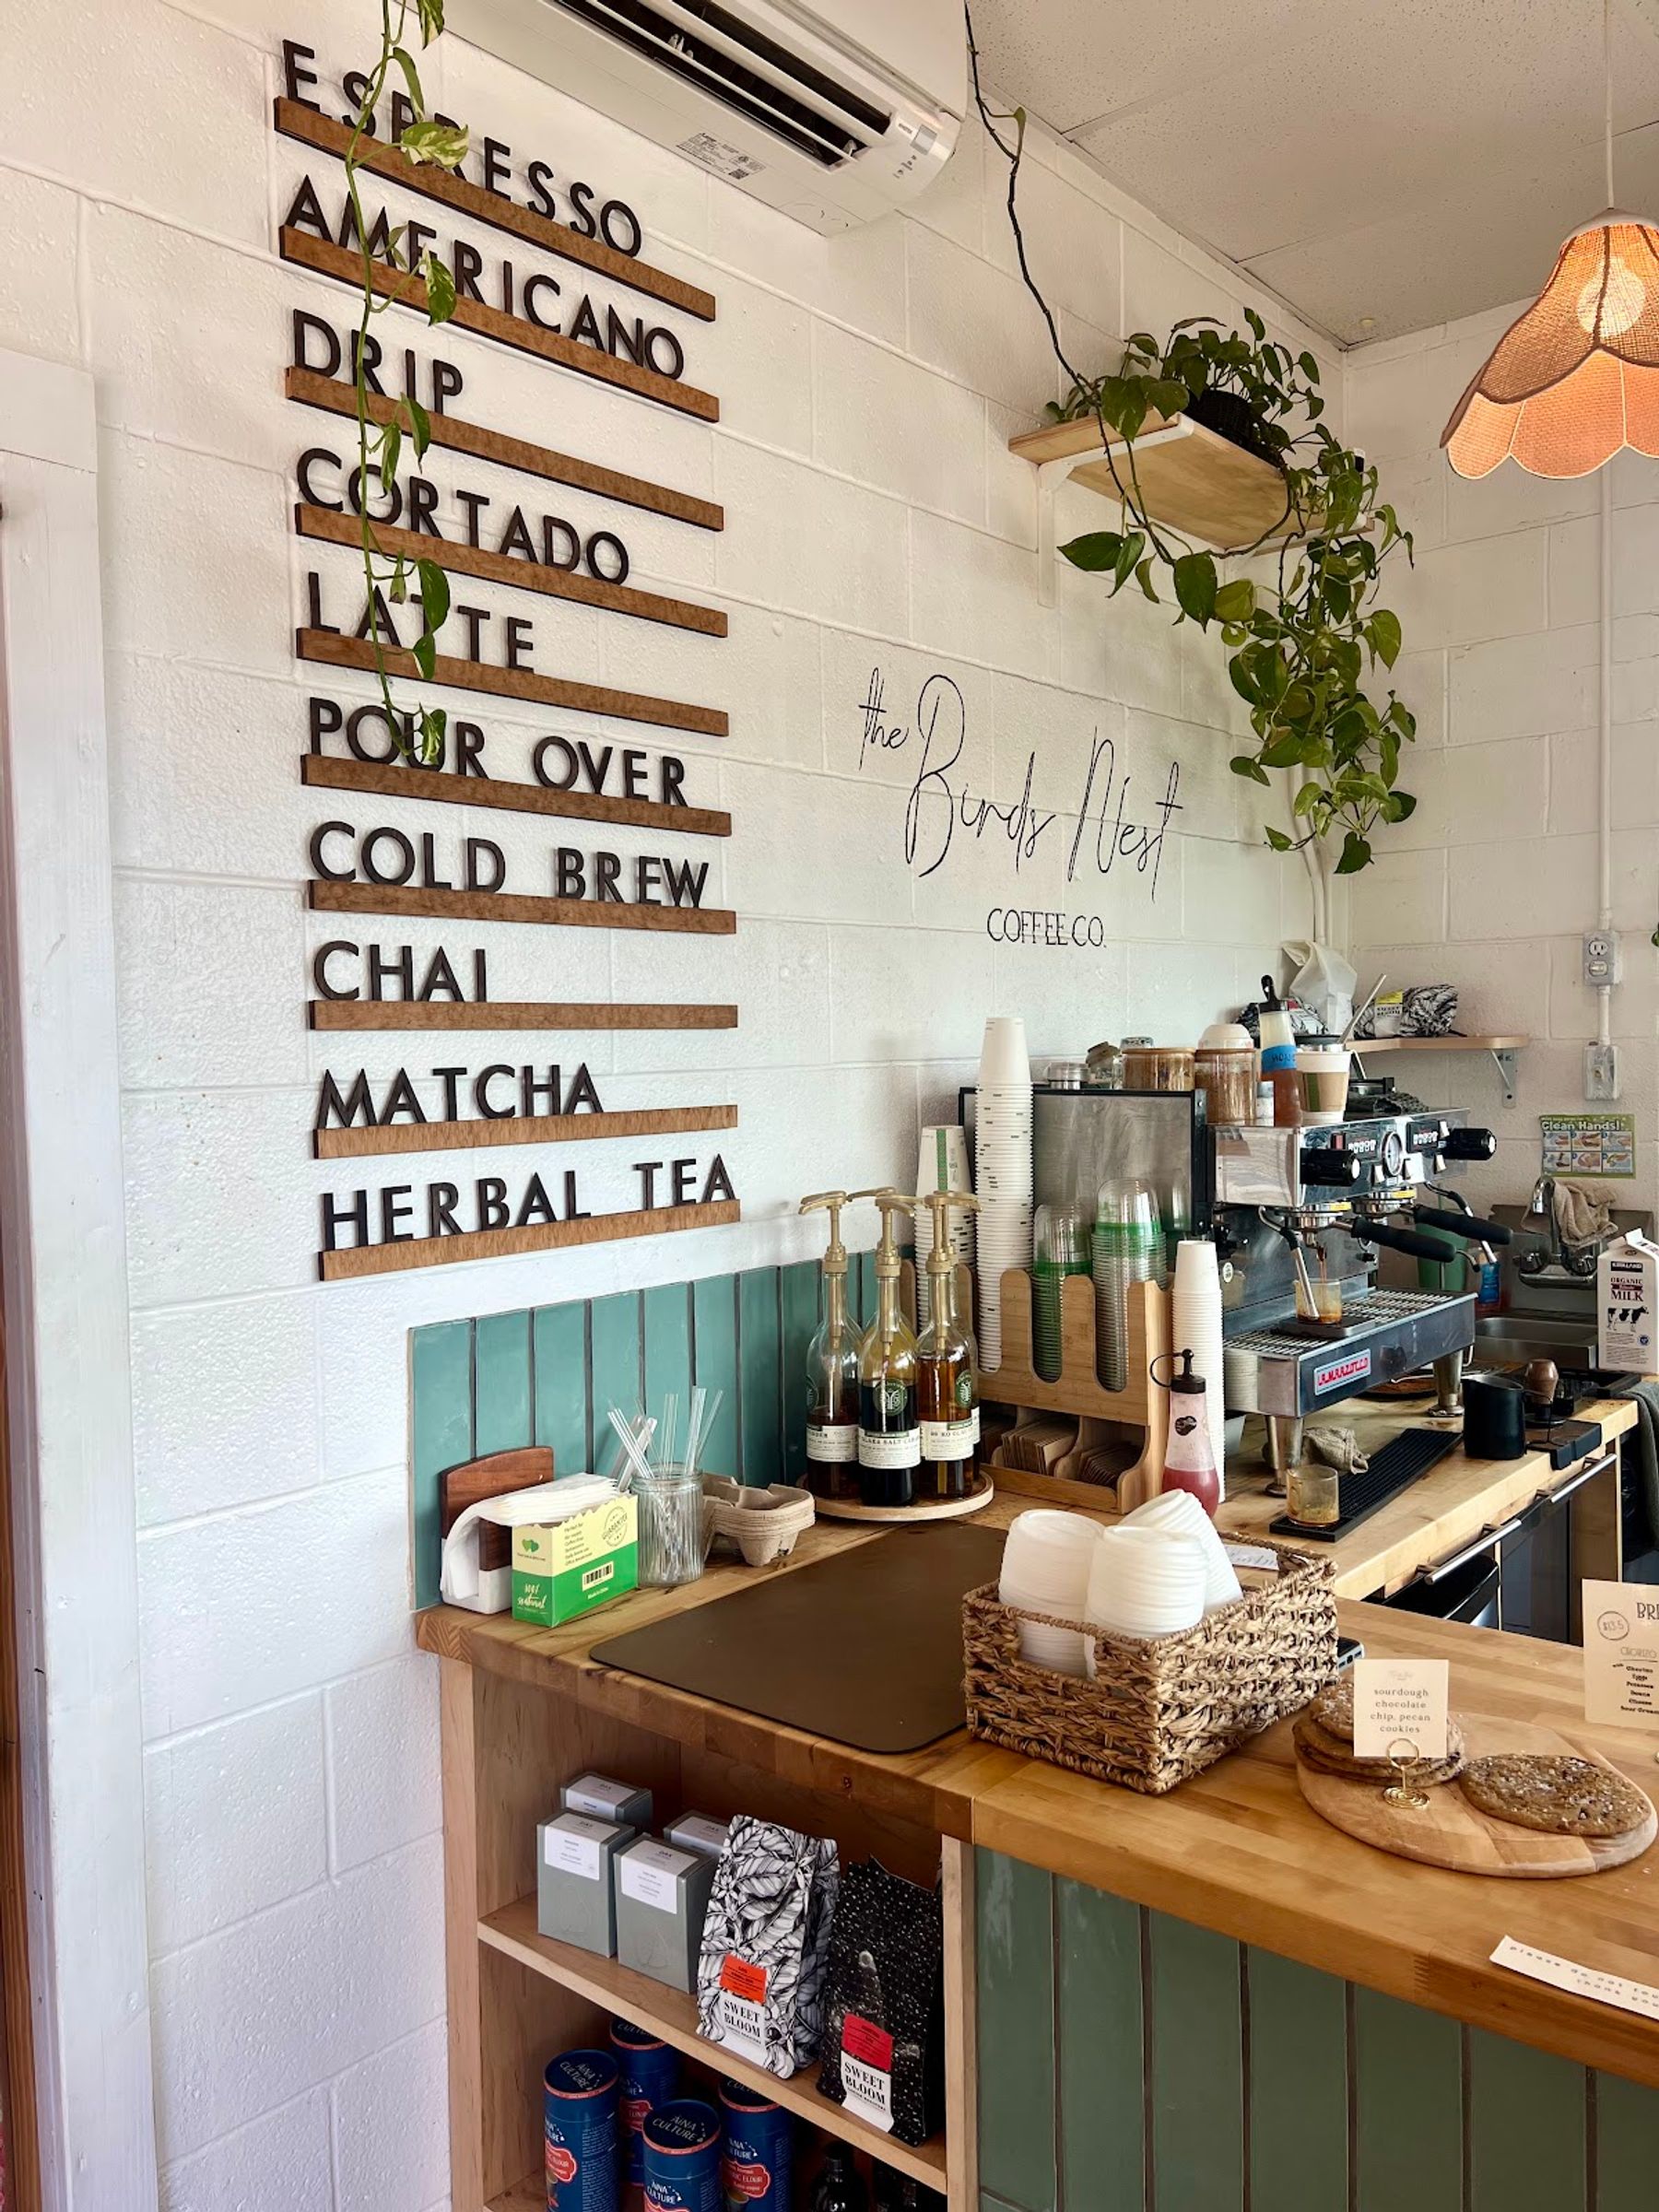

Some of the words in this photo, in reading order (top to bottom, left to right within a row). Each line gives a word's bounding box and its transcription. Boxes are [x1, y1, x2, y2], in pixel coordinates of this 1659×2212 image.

[285, 174, 684, 381] AMERICANO
[294, 309, 464, 414] DRIP
[296, 448, 629, 586] CORTADO
[310, 697, 489, 780] POUR
[534, 735, 688, 807] OVER
[858, 667, 910, 771] the
[905, 674, 1056, 877] Birds
[1067, 726, 1183, 903] Nest
[310, 820, 506, 893] COLD
[557, 847, 709, 909] BREW
[987, 908, 1068, 946] COFFEE
[313, 940, 488, 1003] CHAI
[316, 1063, 605, 1130] MATCHA
[1541, 1121, 1575, 1131] Clean
[1579, 1120, 1620, 1131] Hands!
[322, 1171, 592, 1251] HERBAL
[633, 1153, 736, 1211] TEA
[1610, 1289, 1644, 1302] MILK
[1373, 1688, 1430, 1700] sourdough
[1375, 1700, 1427, 1709] chocolate
[1510, 1946, 1560, 1967] please
[724, 1999, 760, 2024] SWEET
[724, 2012, 760, 2038] BLOOM
[559, 2061, 590, 2090] CULTURE
[844, 2061, 885, 2091] SWEET
[845, 2075, 886, 2105] BLOOM
[652, 2118, 697, 2142] CULTURE
[647, 2185, 676, 2206] CULTURE
